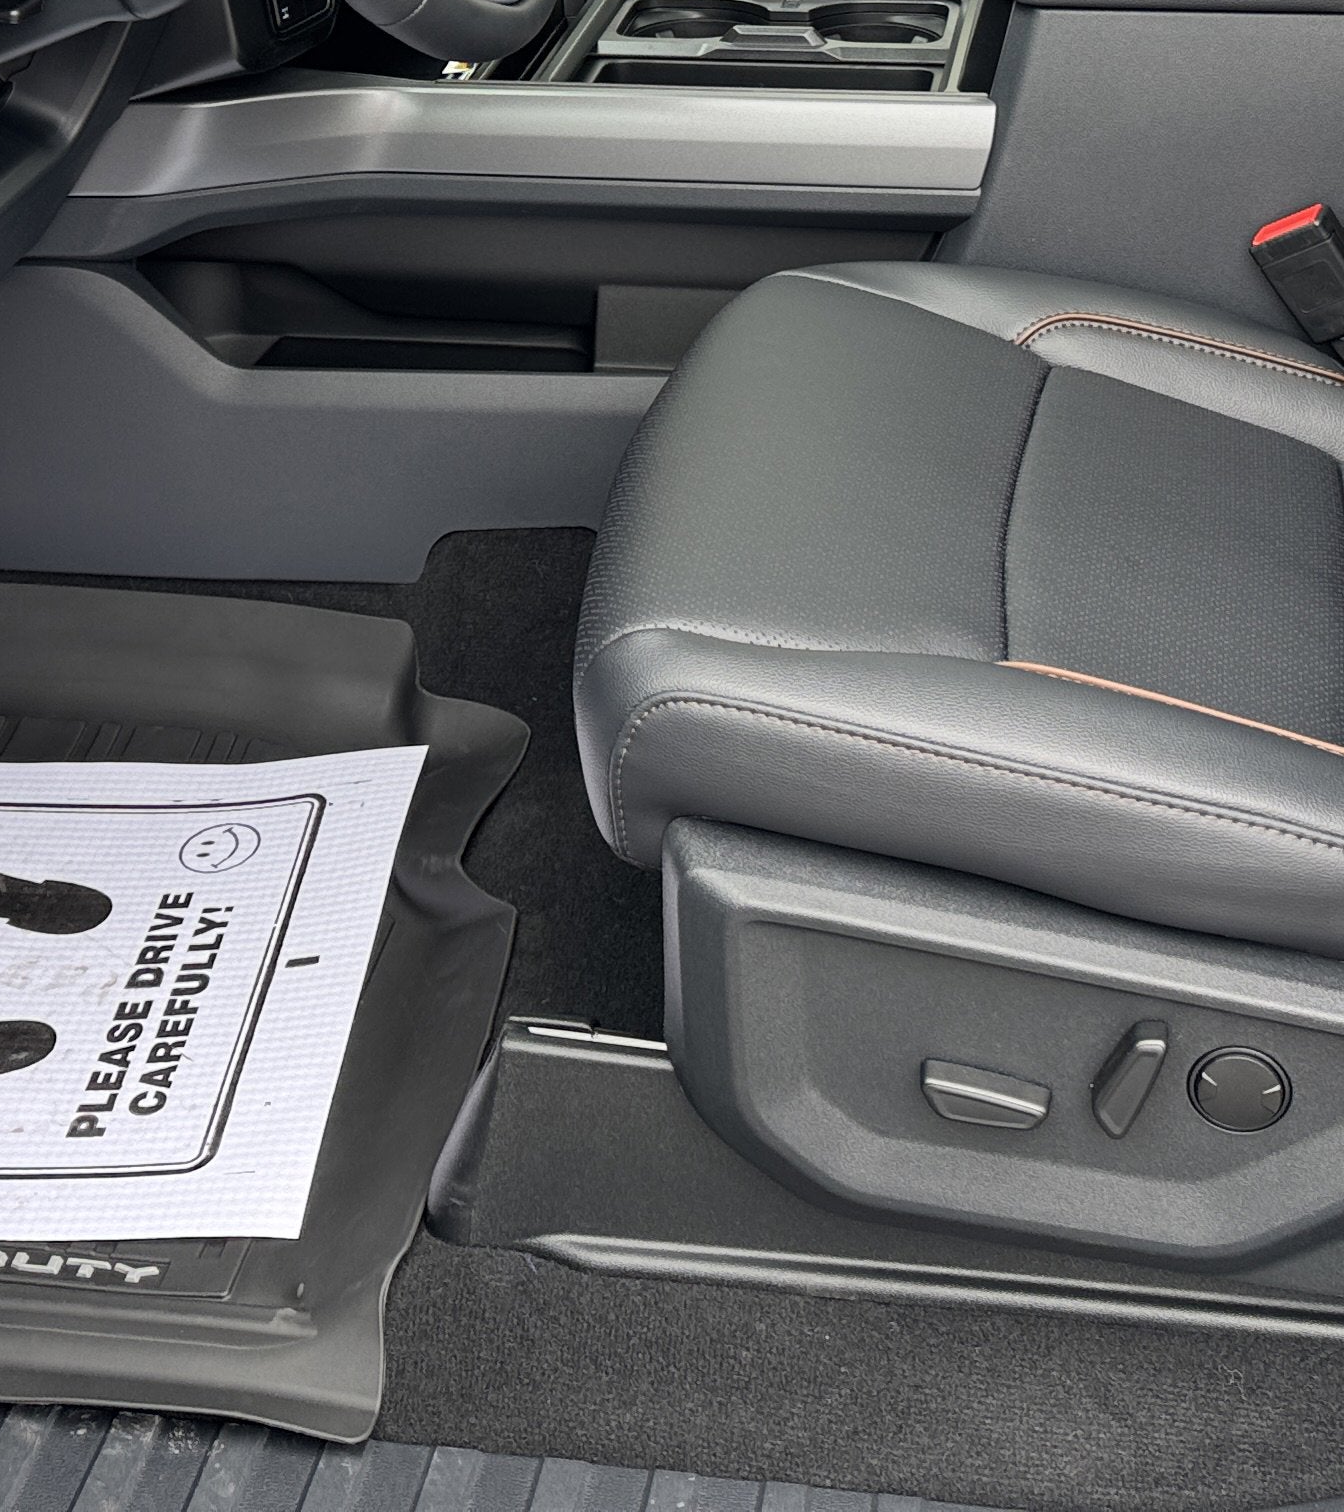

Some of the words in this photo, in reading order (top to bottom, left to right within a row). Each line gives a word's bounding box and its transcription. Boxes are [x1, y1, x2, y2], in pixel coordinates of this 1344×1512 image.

[66, 999, 154, 1138] PLEASE
[124, 891, 195, 990] DRIVE
[128, 905, 235, 1116] CAREFULLY!
